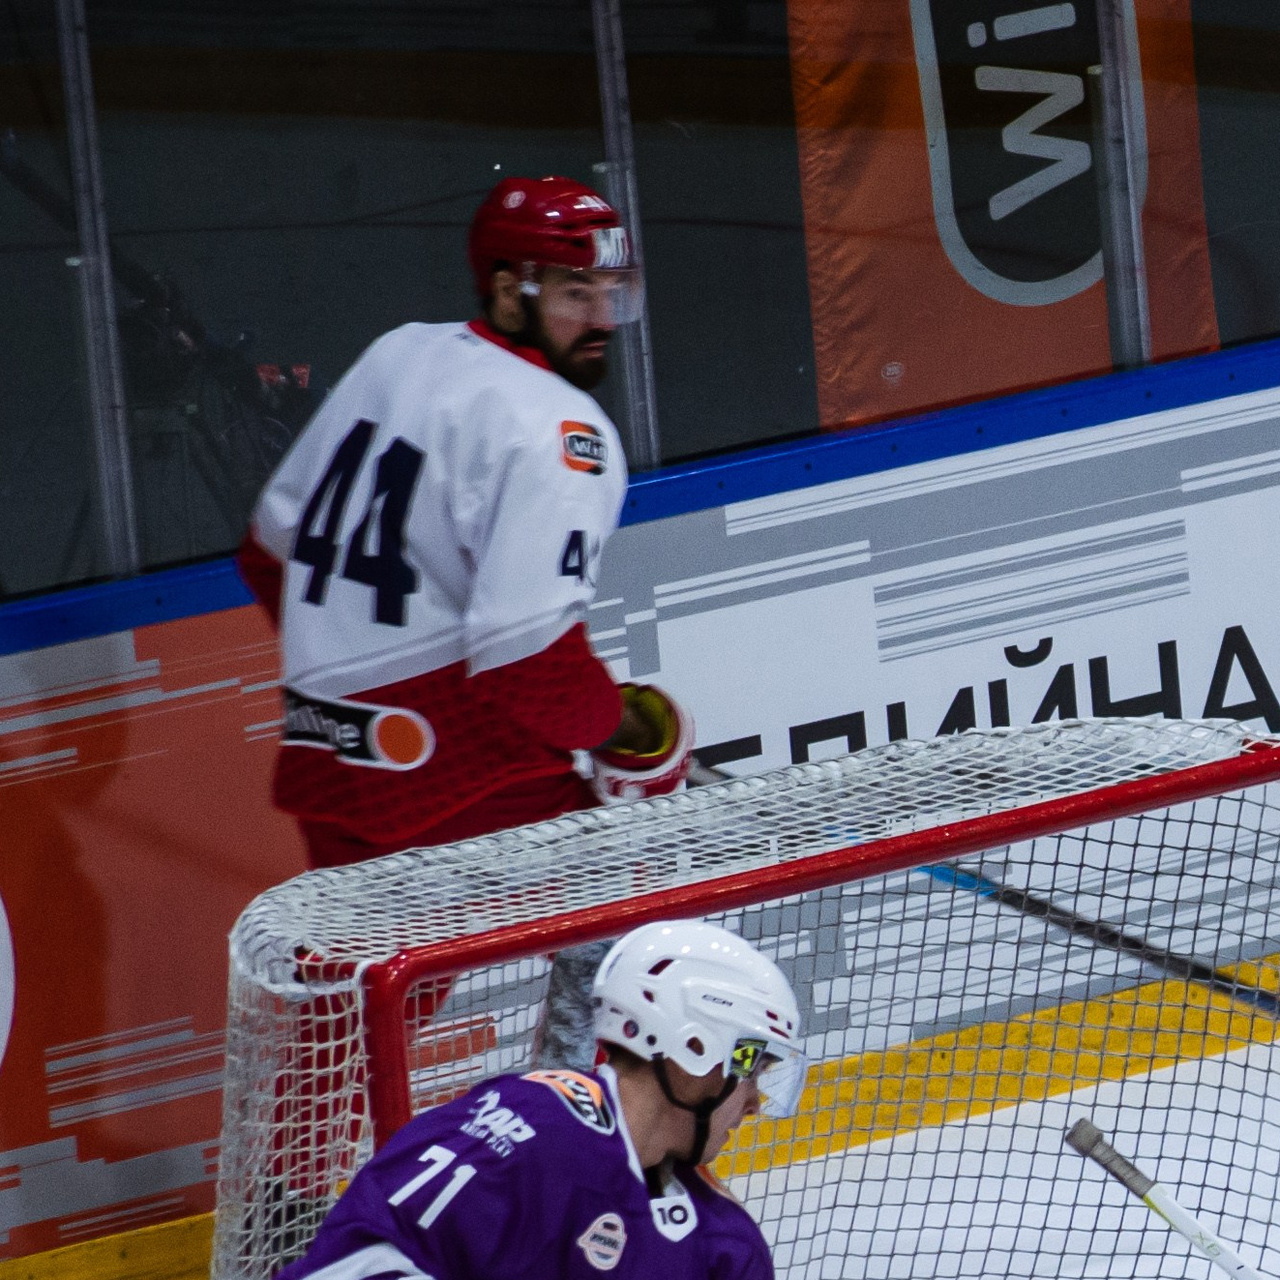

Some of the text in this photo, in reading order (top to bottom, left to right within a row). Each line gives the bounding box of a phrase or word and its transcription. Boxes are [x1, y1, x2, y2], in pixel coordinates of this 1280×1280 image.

[291, 419, 424, 627] 44
[388, 1146, 478, 1230] 71
[657, 1204, 689, 1225] 10
